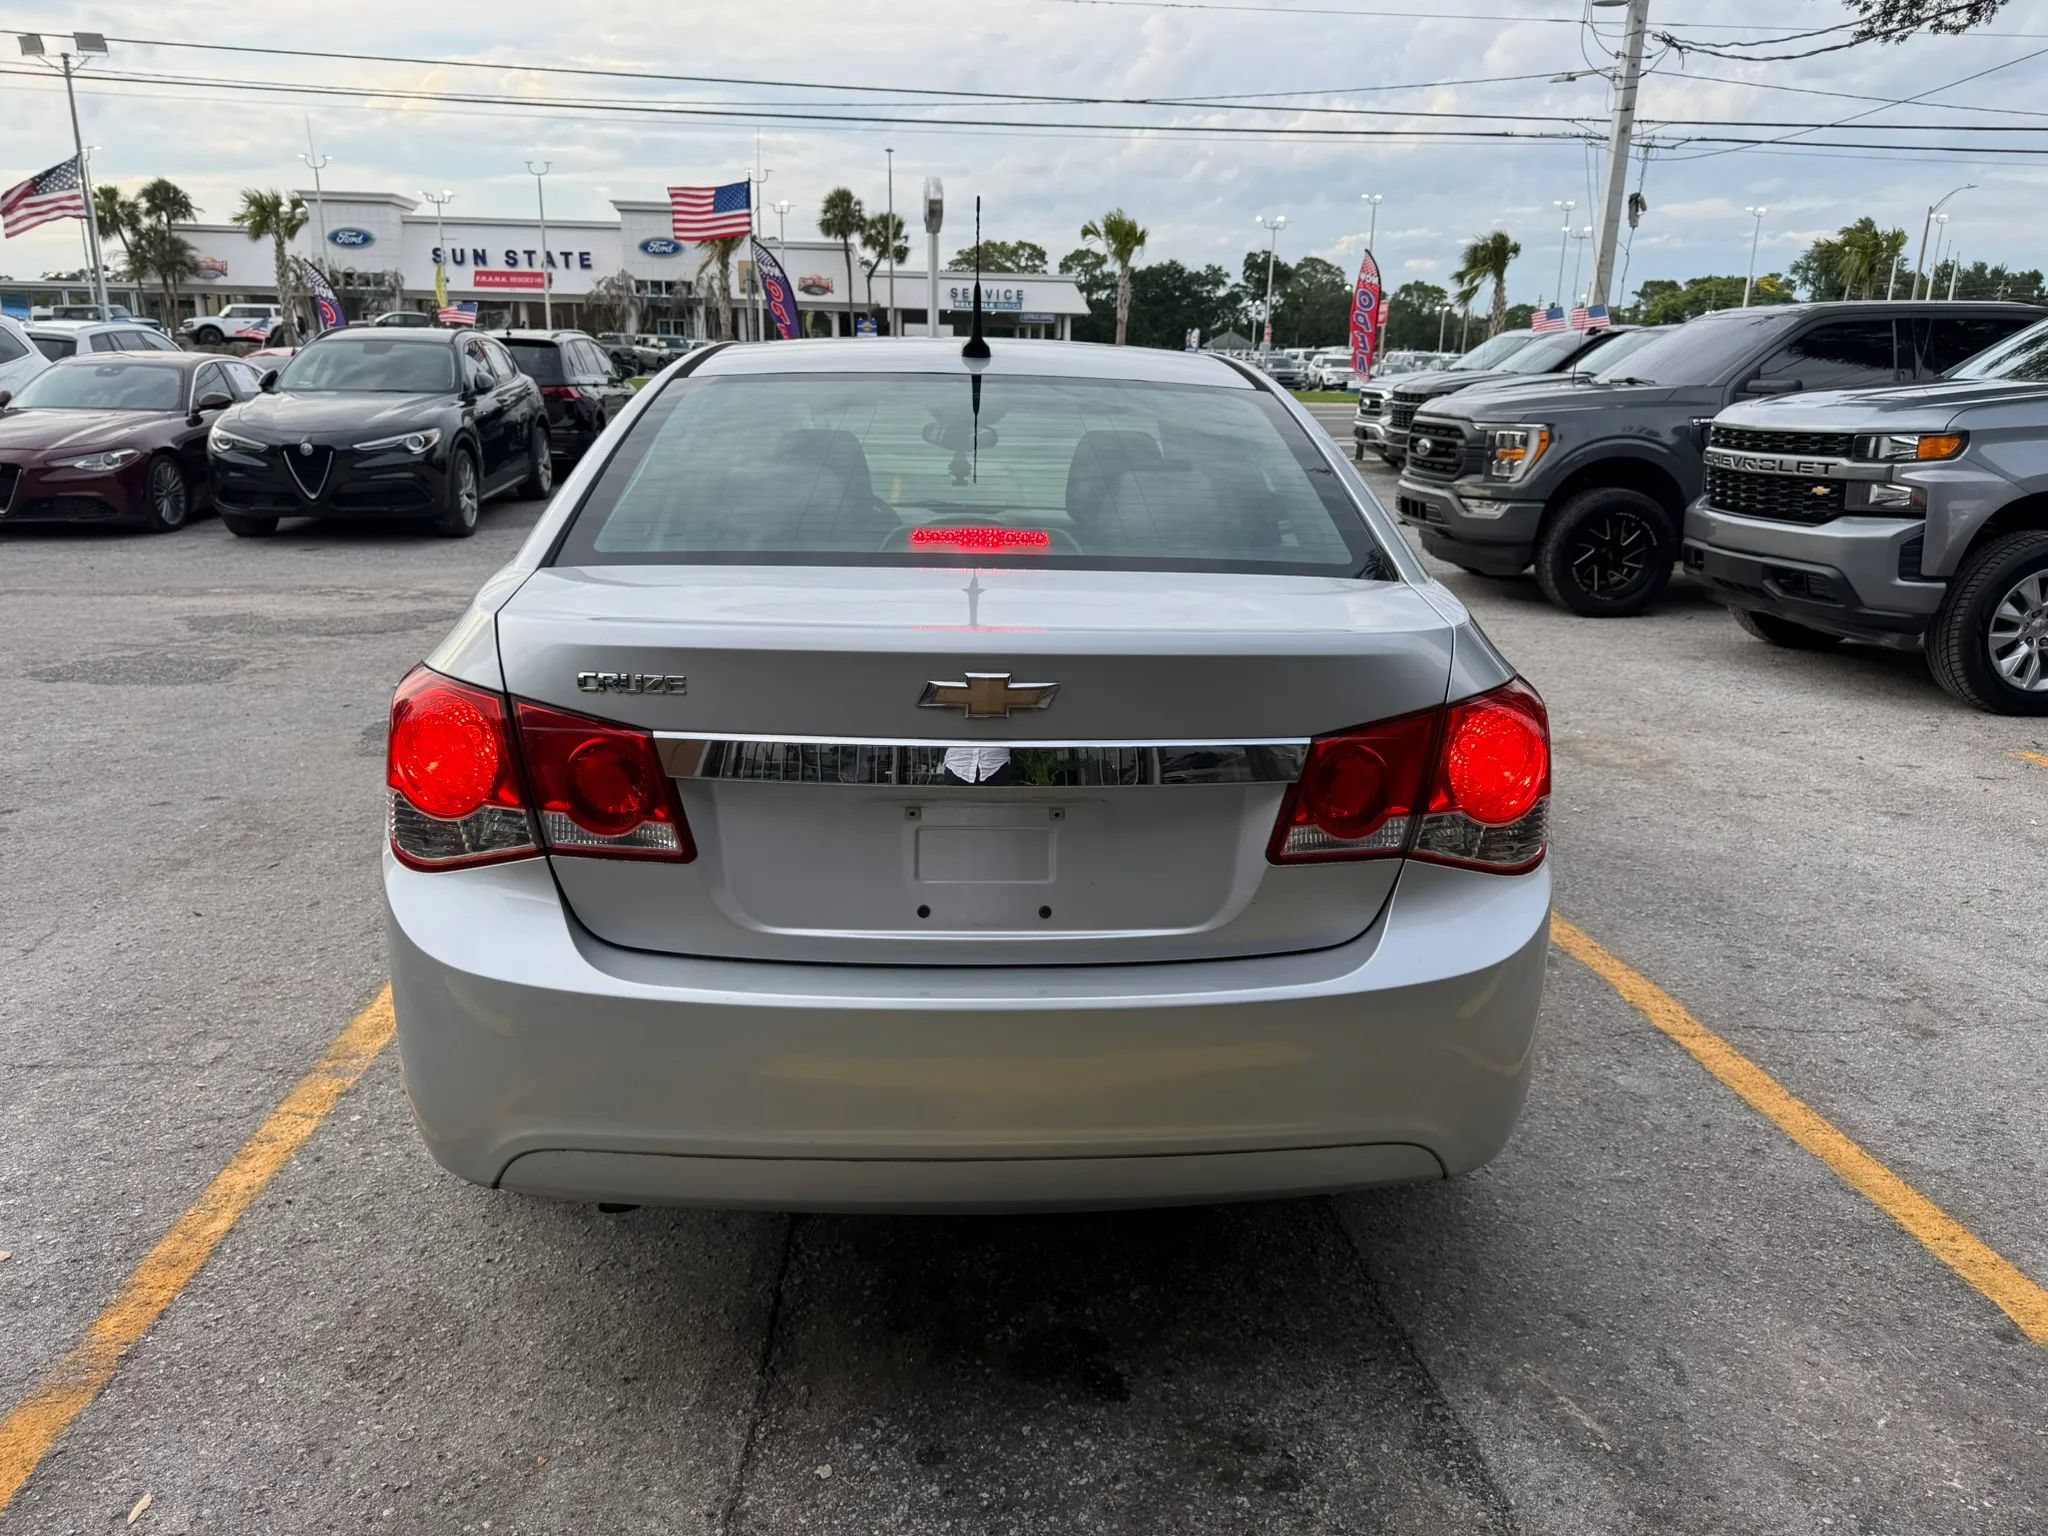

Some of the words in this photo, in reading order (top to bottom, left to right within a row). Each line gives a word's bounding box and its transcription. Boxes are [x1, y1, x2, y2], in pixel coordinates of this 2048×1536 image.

[336, 231, 364, 244] Ford
[647, 241, 674, 252] Ford
[432, 247, 487, 266] SUN
[505, 250, 592, 269] STATE
[950, 288, 1024, 300] SEVICE
[1703, 451, 1837, 476] CHEVROLET
[577, 672, 687, 695] CRUZE
